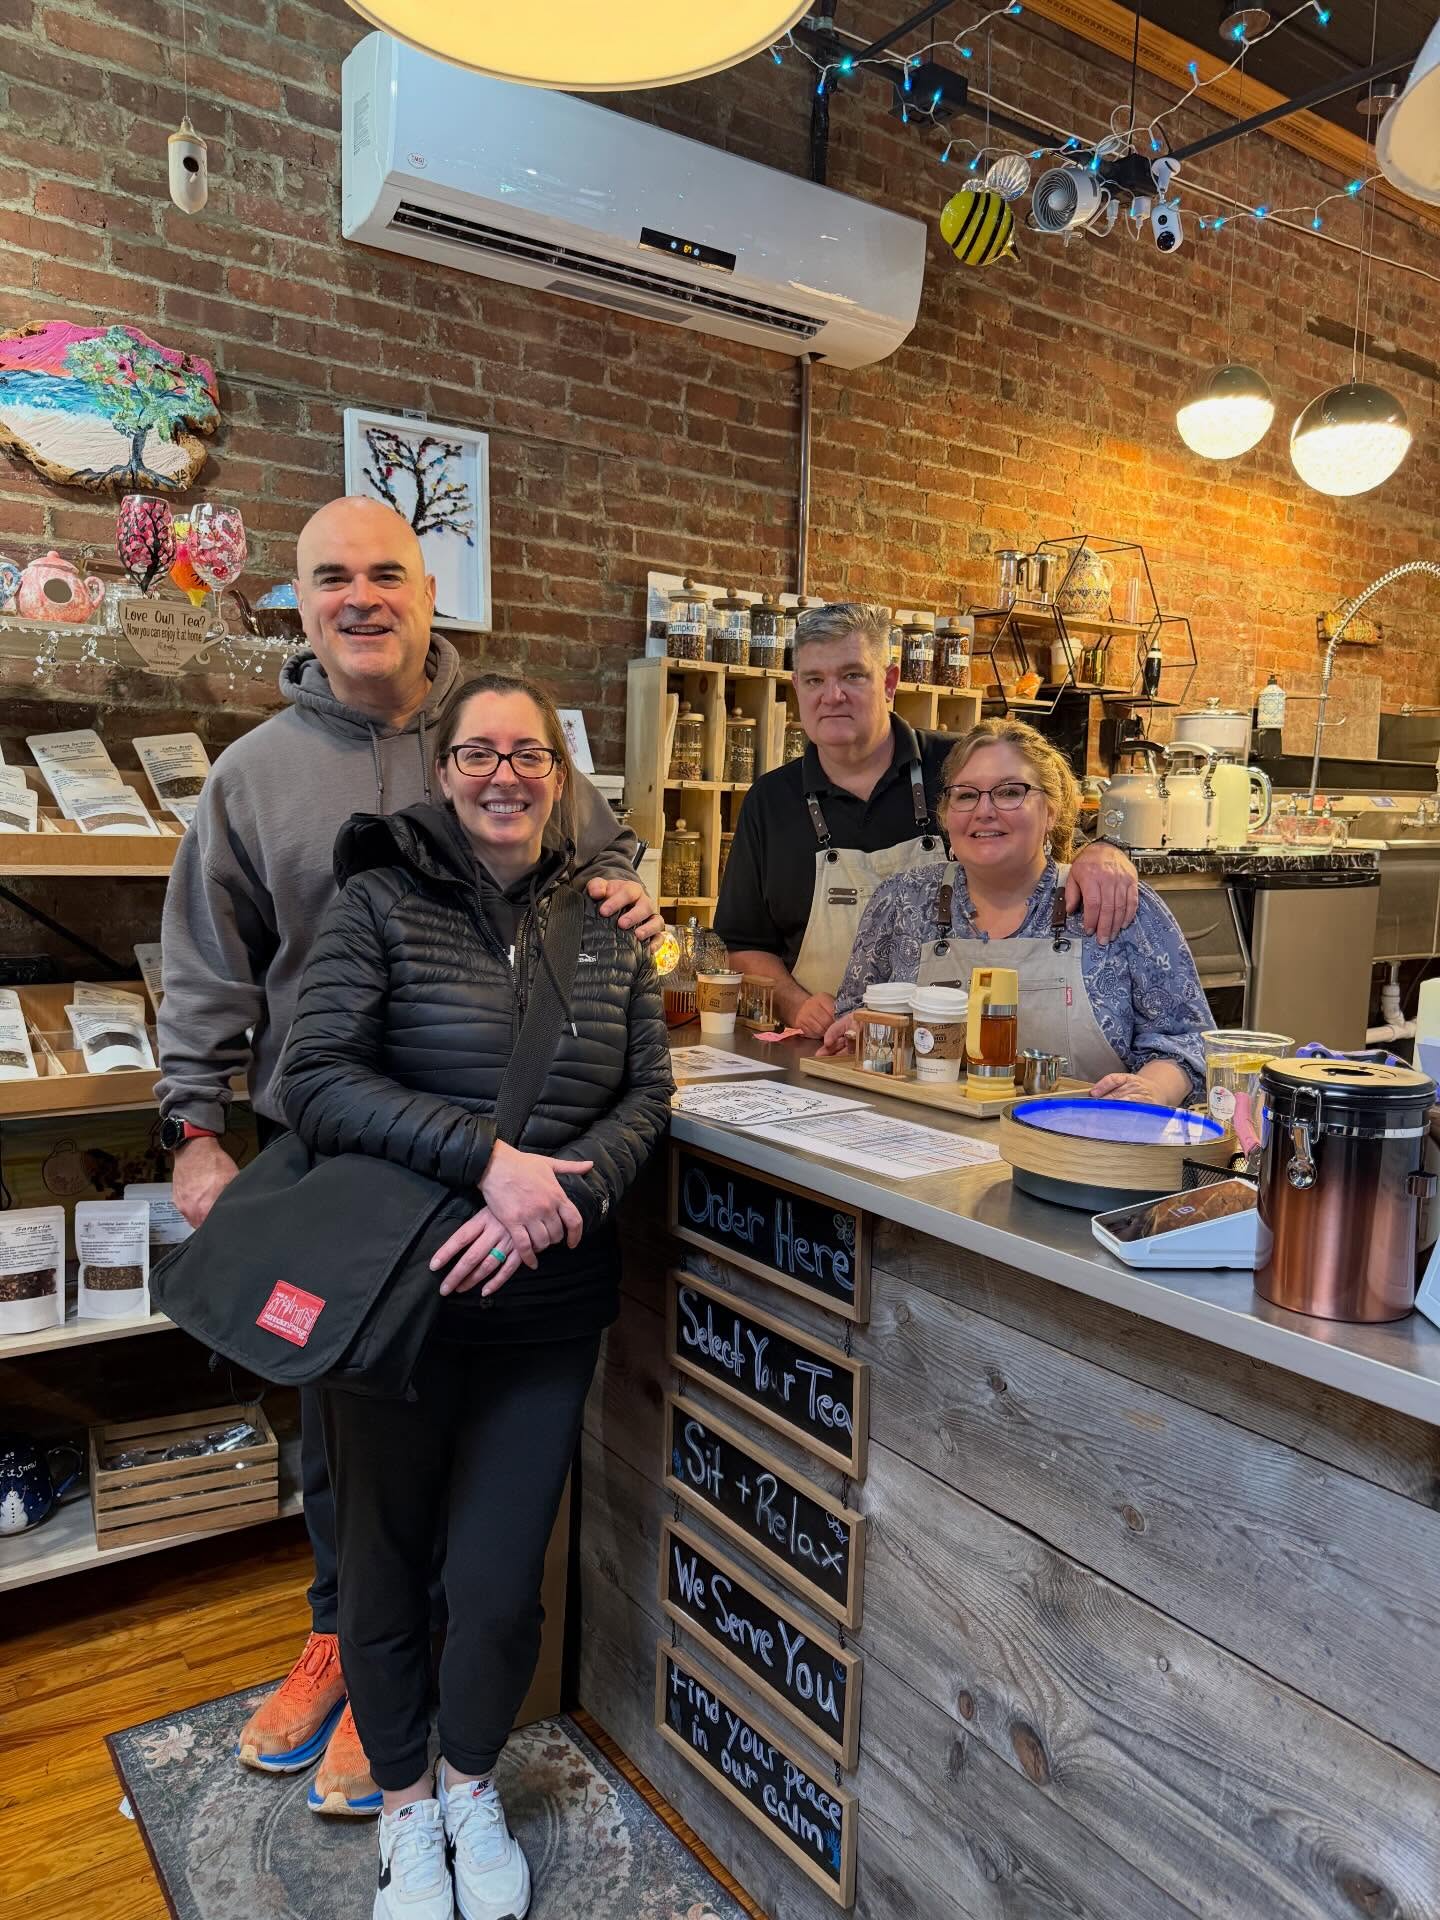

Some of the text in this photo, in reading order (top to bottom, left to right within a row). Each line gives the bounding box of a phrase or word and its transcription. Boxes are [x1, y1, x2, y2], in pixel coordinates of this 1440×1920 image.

[125, 607, 148, 622] Love
[183, 613, 206, 628] Tea?
[126, 623, 142, 635] Now
[139, 627, 150, 639] you
[150, 627, 161, 638] can
[161, 627, 176, 643] enjoy
[187, 631, 202, 642] home
[668, 622, 697, 633] Pumpkin
[716, 627, 737, 638] Coffee
[683, 1167, 855, 1291] Order Here
[678, 1285, 746, 1378] Select
[795, 1359, 853, 1438] Tea
[16, 1460, 37, 1478] Snow
[684, 1420, 844, 1575] Sit + Relax
[674, 1545, 840, 1723] We Serve You
[670, 1662, 720, 1725] Find
[691, 1714, 709, 1752] in
[720, 1748, 759, 1789] our
[400, 1804, 416, 1818] NIKE
